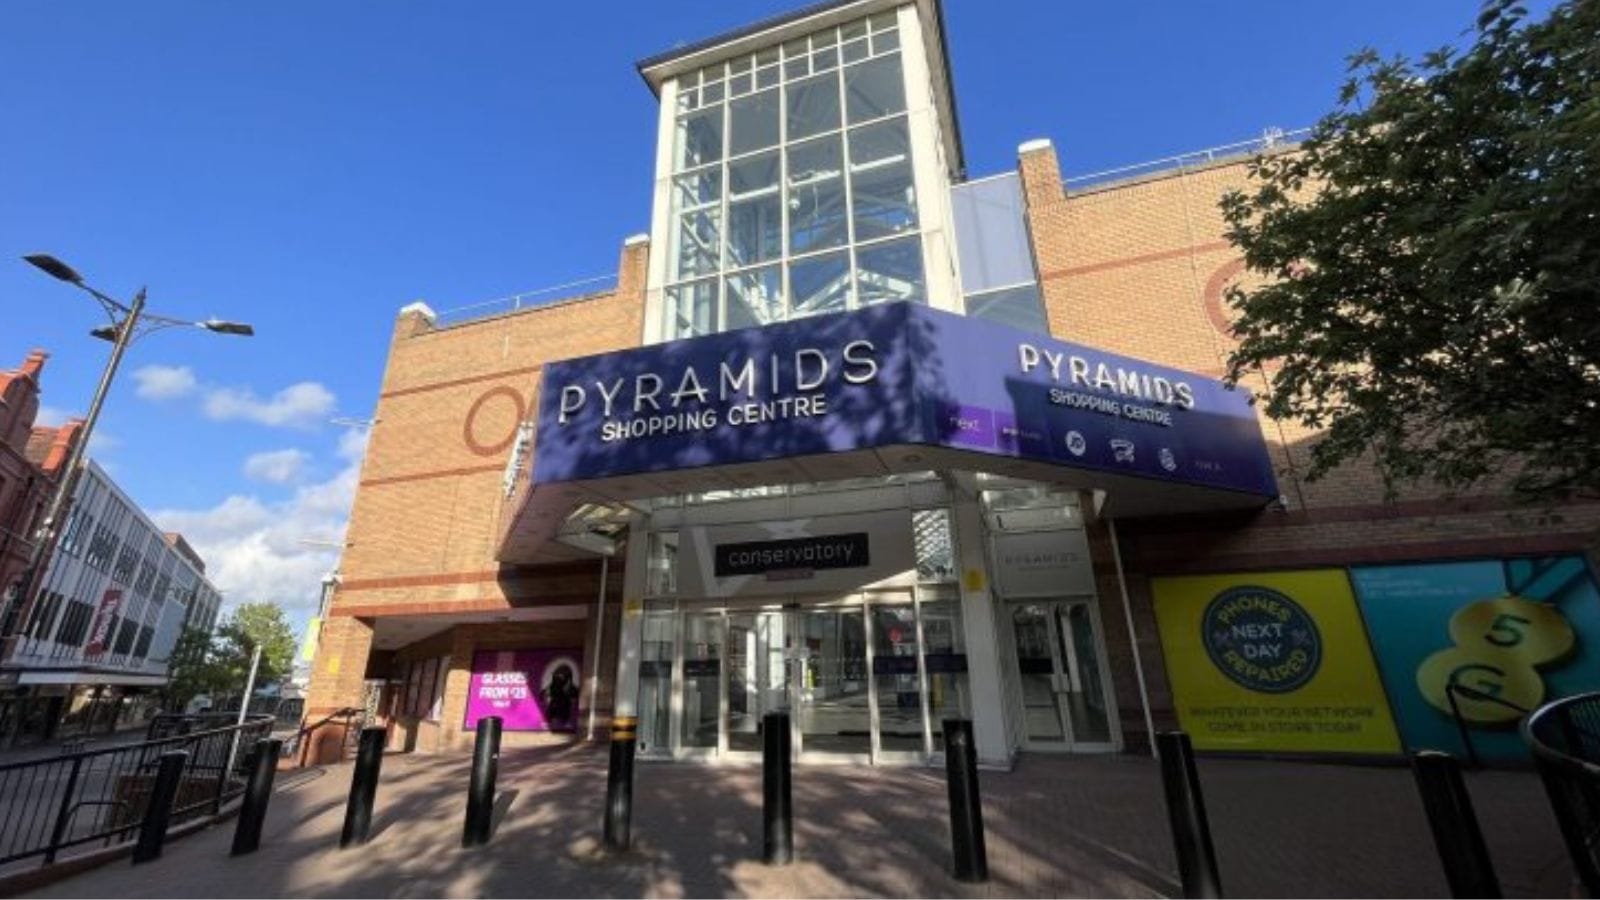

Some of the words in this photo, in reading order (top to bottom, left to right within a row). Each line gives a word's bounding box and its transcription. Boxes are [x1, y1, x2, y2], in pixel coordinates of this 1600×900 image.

[558, 340, 879, 424] PYRAMIDS
[1018, 343, 1195, 409] PYRAMIDS
[601, 409, 718, 442] SHOPPING
[727, 395, 827, 426] CENTRE
[1049, 388, 1120, 415] SHOPPING
[1122, 404, 1173, 427] CENTRE
[728, 542, 855, 567] conservatory
[1218, 596, 1293, 624] PHONES
[1231, 622, 1283, 641] NEXT
[1484, 613, 1532, 648] 5
[1223, 648, 1309, 683] REPAIRED
[1243, 642, 1283, 661] DAY
